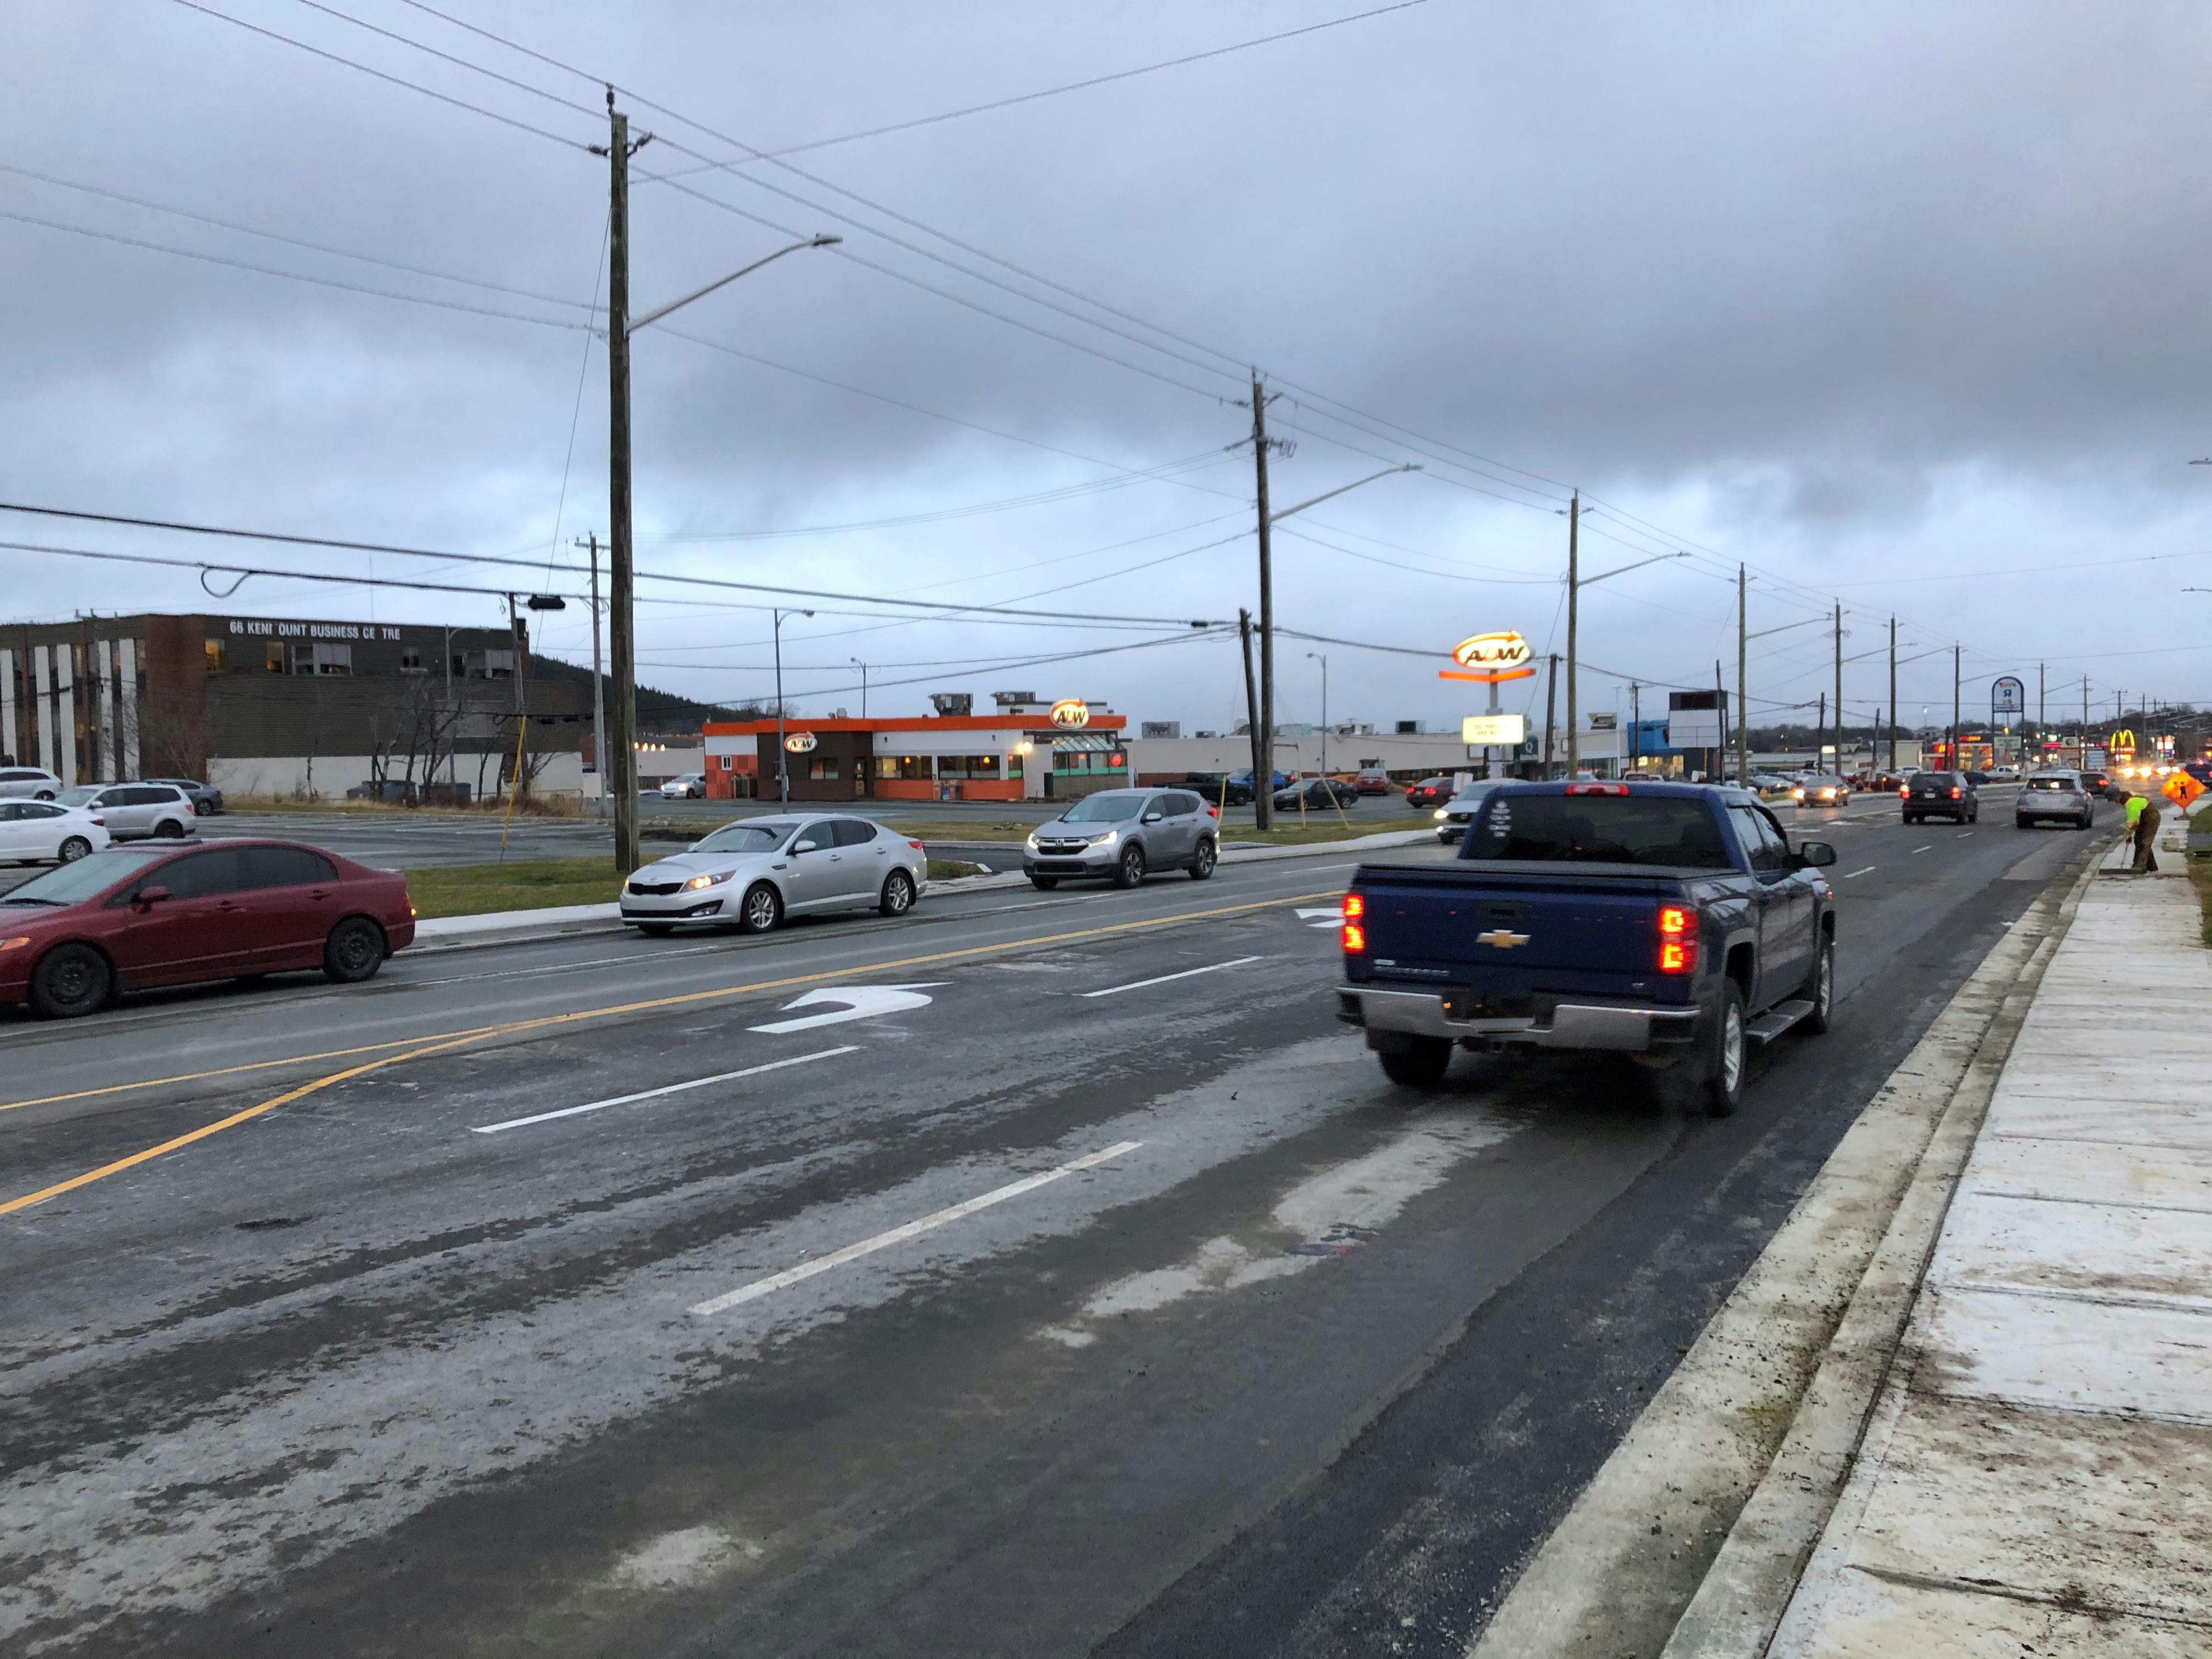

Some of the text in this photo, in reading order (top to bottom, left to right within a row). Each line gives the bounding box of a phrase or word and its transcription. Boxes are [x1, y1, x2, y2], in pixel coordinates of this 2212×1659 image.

[229, 620, 244, 634] 66
[310, 624, 359, 639] BUSINESS
[1054, 709, 1086, 724] A&W
